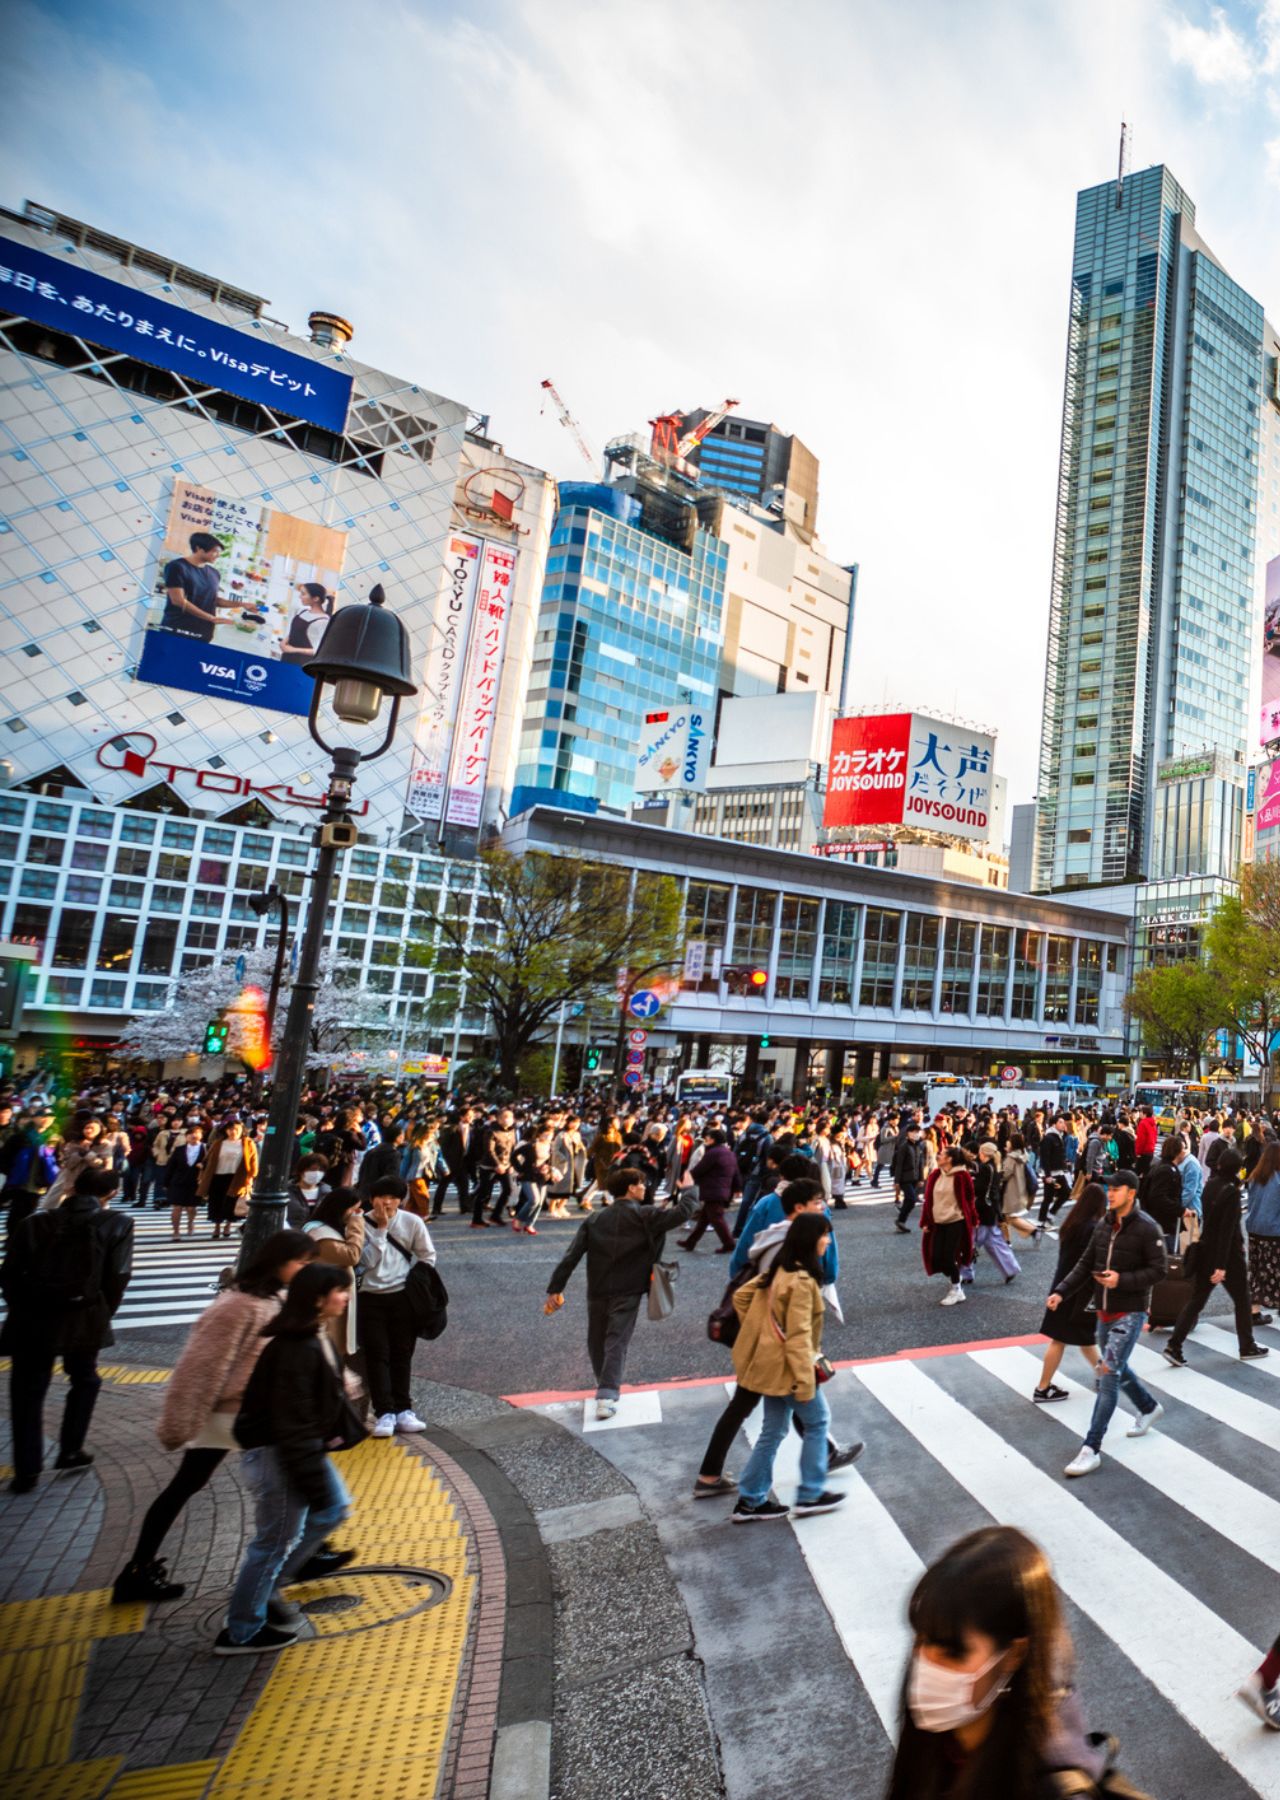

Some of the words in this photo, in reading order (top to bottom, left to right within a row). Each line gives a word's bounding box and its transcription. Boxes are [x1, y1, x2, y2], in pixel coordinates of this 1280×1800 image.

[184, 489, 248, 515] Visaが使える
[180, 512, 240, 535] Visaデビット
[199, 661, 237, 681] VISA
[638, 716, 686, 767] SANKYO
[684, 714, 706, 783] SANKYO
[832, 747, 906, 774] カラオケ
[911, 731, 992, 780] 大声
[829, 773, 905, 793] JOYSOUND
[906, 796, 988, 828] JOYSOUND
[1140, 911, 1176, 926] MARK
